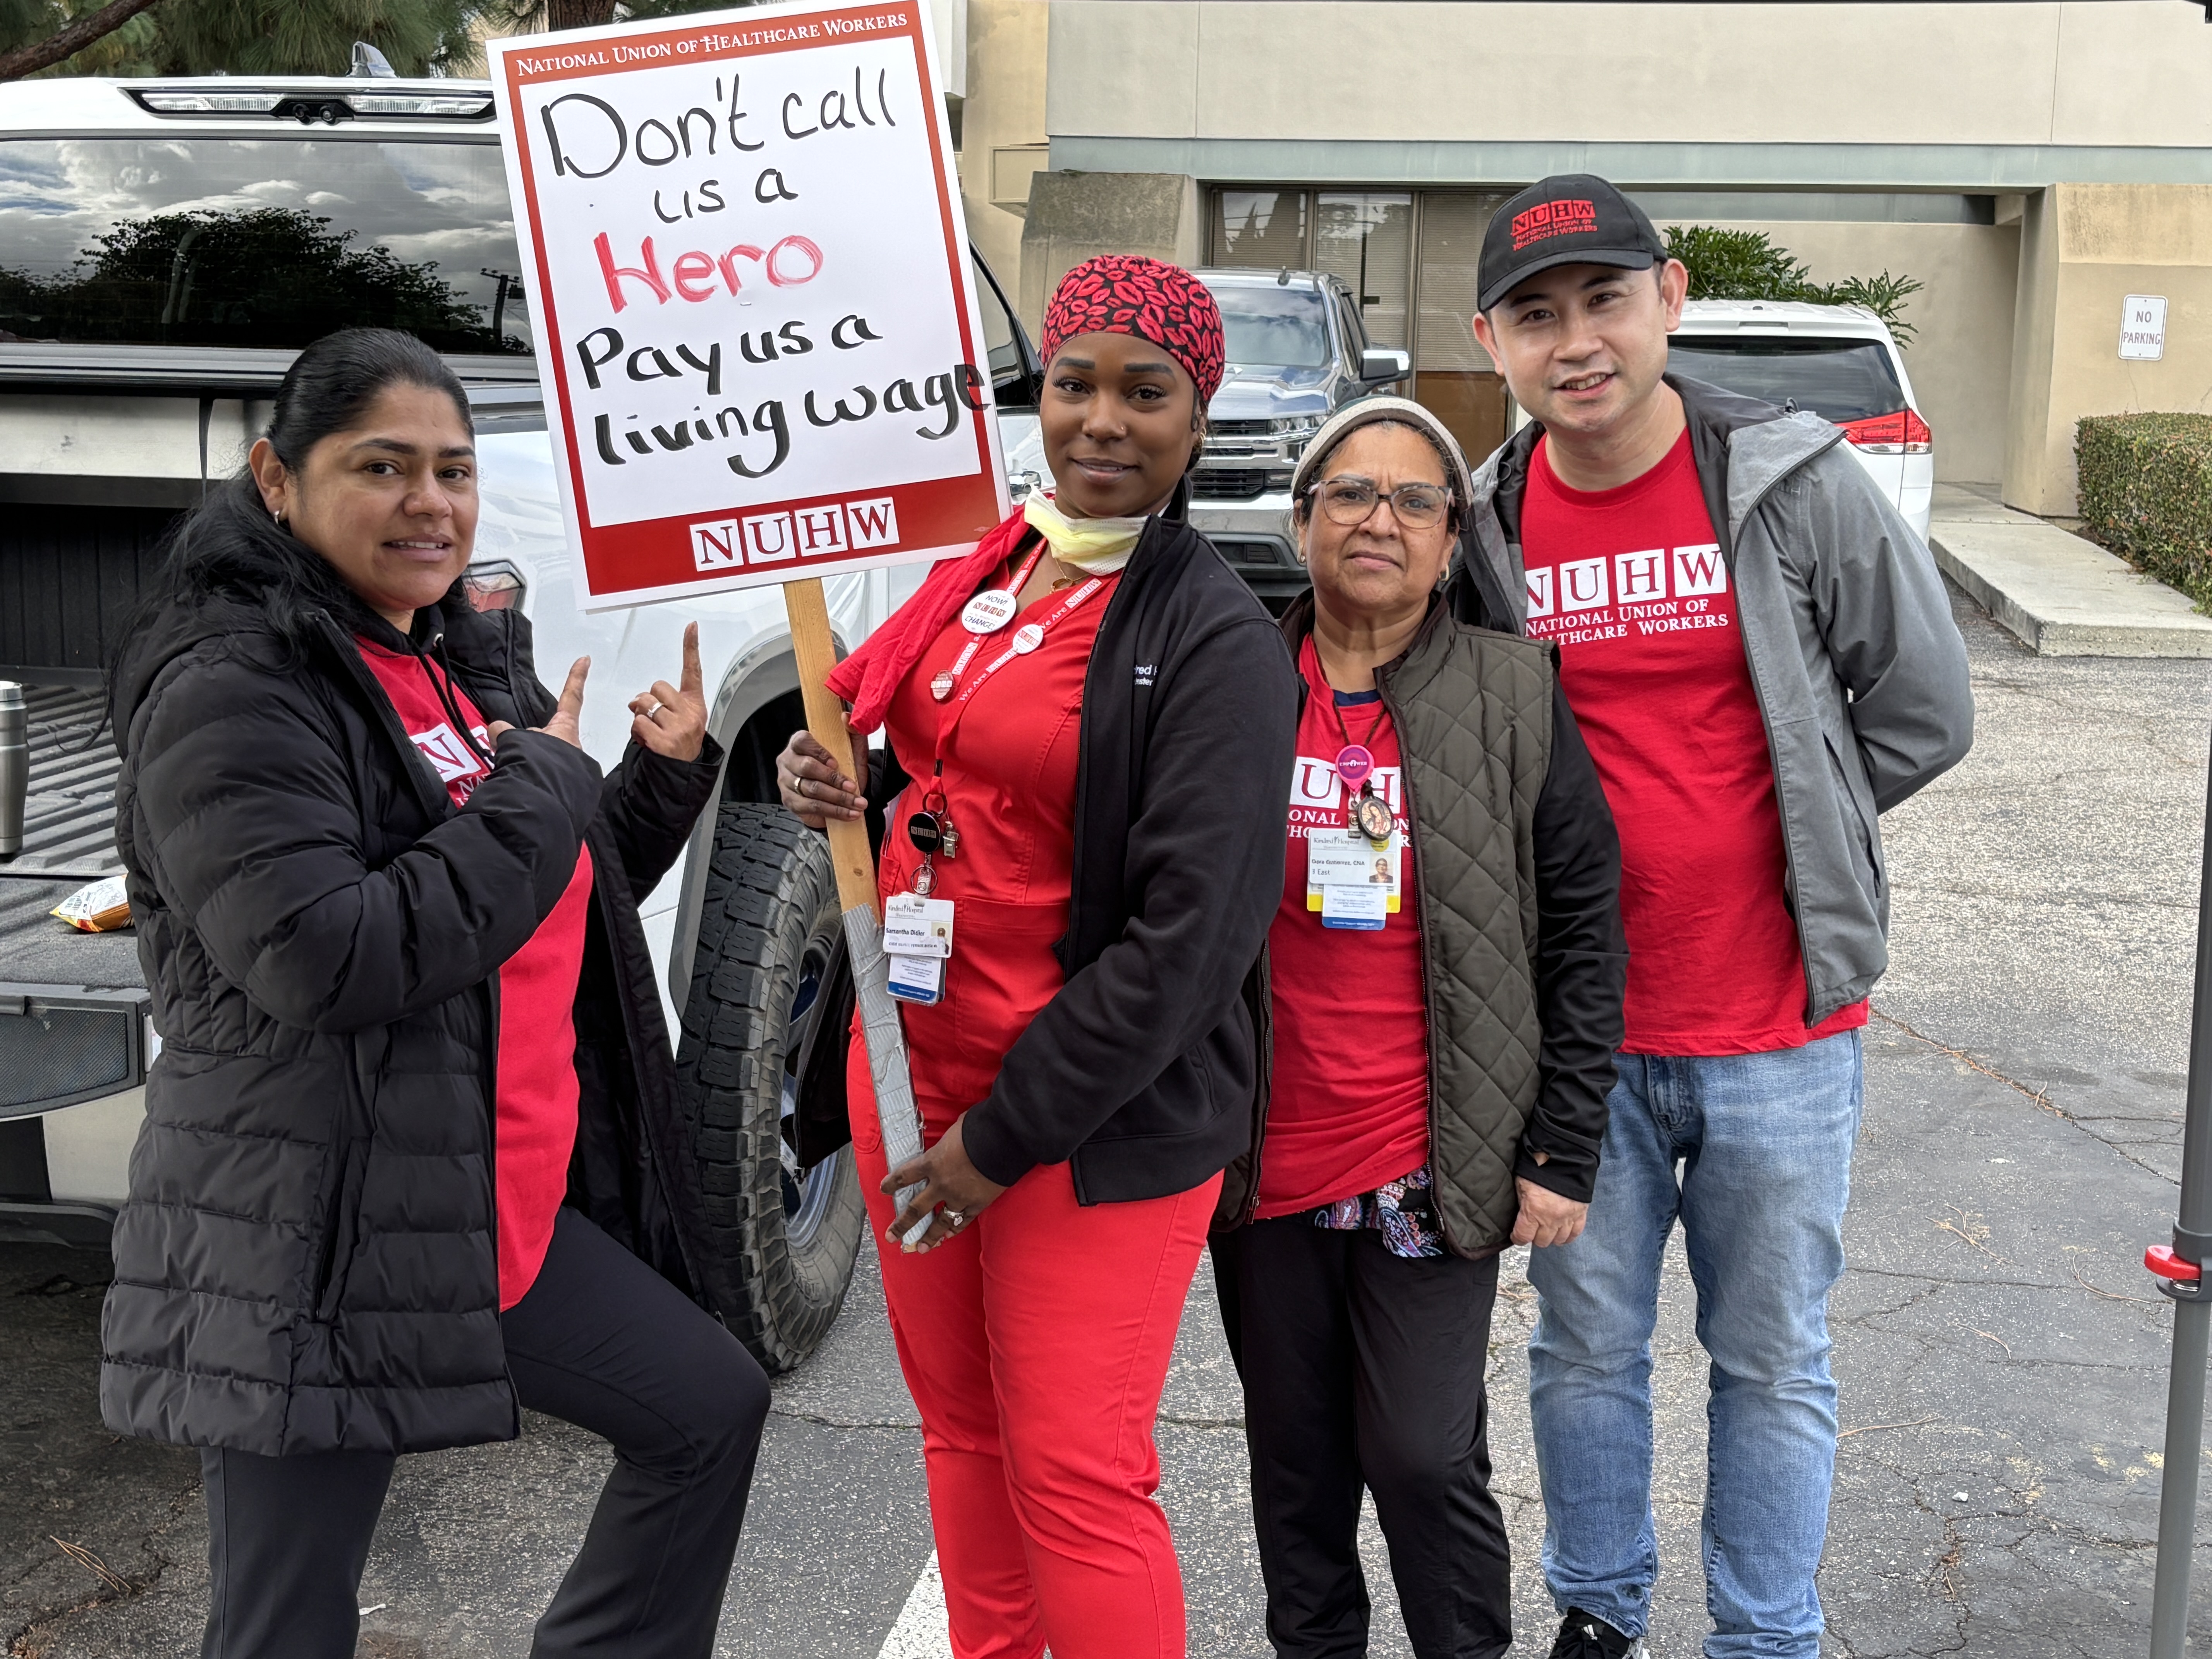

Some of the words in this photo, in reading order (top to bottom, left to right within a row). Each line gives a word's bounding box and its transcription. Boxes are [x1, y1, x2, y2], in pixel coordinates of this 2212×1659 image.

[516, 52, 610, 77] NATIONAL
[612, 43, 671, 63] UNION
[676, 40, 698, 53] OF
[704, 24, 820, 52] HEALTHCARE
[822, 13, 907, 36] WORKERS
[541, 73, 764, 179] Don't
[782, 65, 896, 140] call
[654, 178, 725, 223] us
[755, 168, 799, 203] a
[1513, 201, 1594, 233] NUHW
[594, 232, 824, 314] Hero
[2123, 331, 2161, 345] PARKING
[2135, 311, 2152, 323] NO
[576, 327, 721, 395] Pay
[740, 321, 814, 363] us
[831, 314, 884, 350] a
[594, 398, 790, 479] living
[804, 364, 991, 440] wage
[696, 503, 892, 565] NUHW
[1526, 551, 1722, 610] NUHW
[1525, 610, 1614, 637] NATIONAL
[1618, 601, 1678, 622] UNION
[1685, 599, 1709, 612] OF
[1637, 613, 1728, 635] WORKERS
